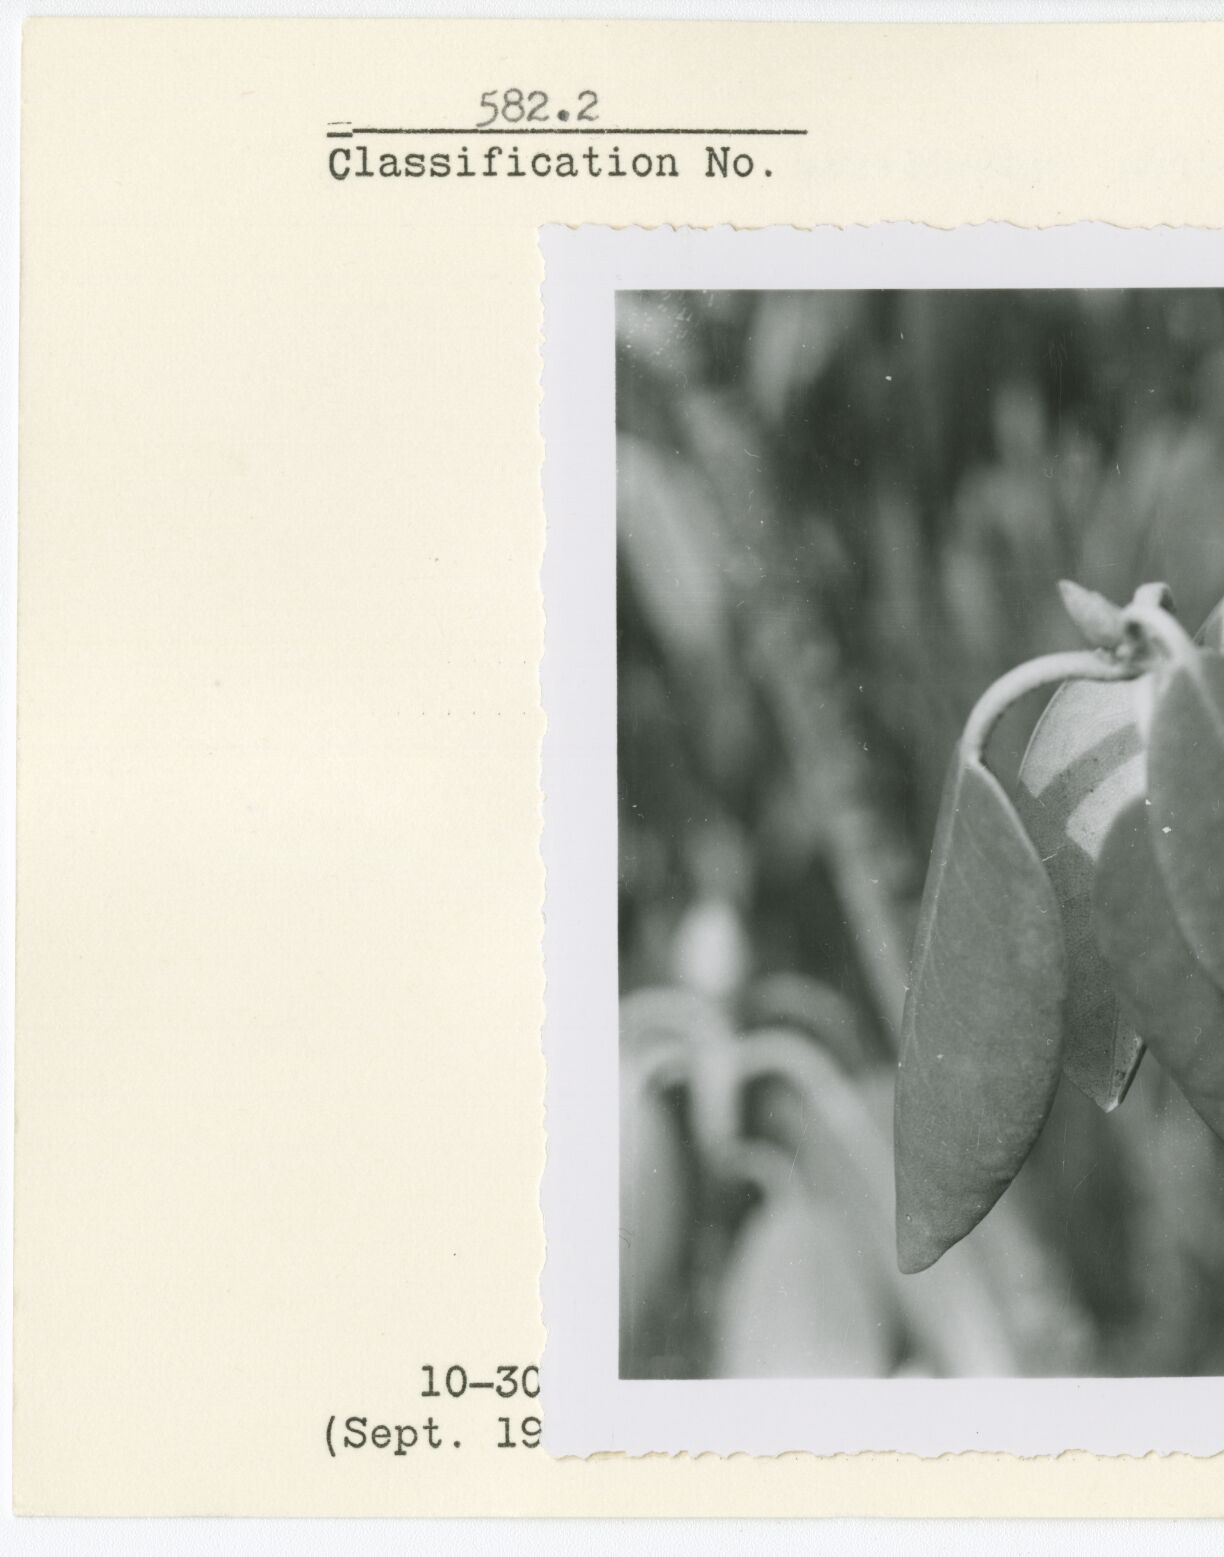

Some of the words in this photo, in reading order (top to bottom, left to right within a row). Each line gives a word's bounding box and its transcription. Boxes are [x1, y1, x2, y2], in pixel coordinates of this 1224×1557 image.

[476, 88, 599, 127] 582.2
[328, 145, 680, 181] Classification
[704, 146, 773, 179] No.
[325, 1415, 461, 1457] (Sept.
[497, 1416, 542, 1449] 19
